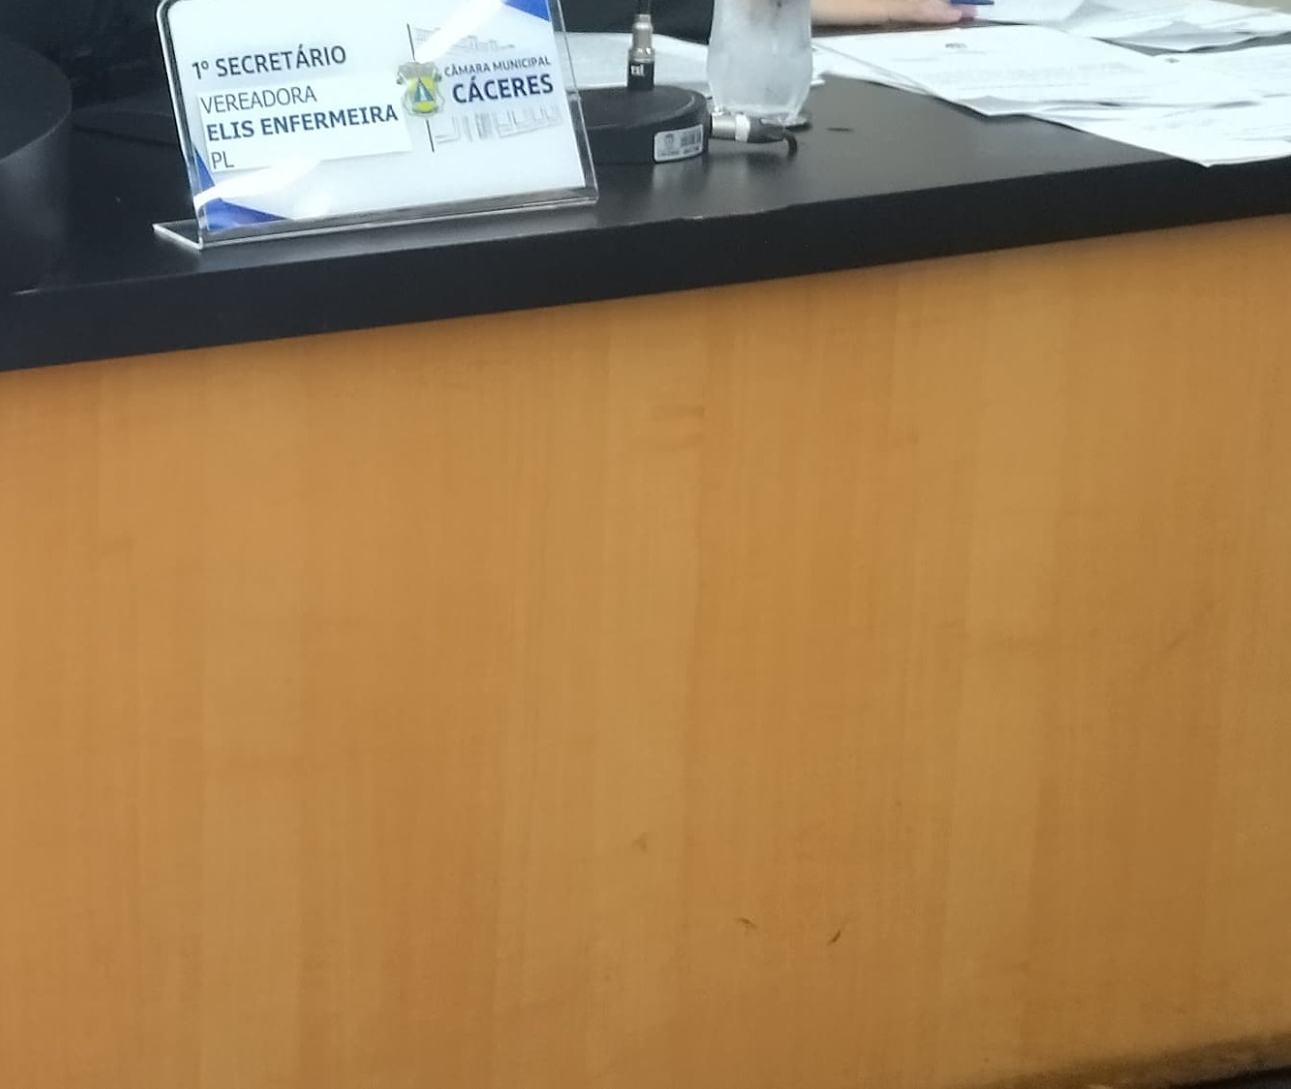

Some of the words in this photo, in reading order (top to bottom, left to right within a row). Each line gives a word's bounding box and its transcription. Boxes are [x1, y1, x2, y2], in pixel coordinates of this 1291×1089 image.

[215, 44, 348, 78] SECRETÁRIO
[444, 61, 491, 77] CÂMARA
[493, 56, 552, 73] MUNICIPAL
[200, 85, 318, 115] VEREADORA
[452, 73, 555, 103] CÁCERES
[207, 118, 255, 142] ELIS
[261, 104, 399, 136] ENFERMEIRA
[211, 151, 235, 170] PL
